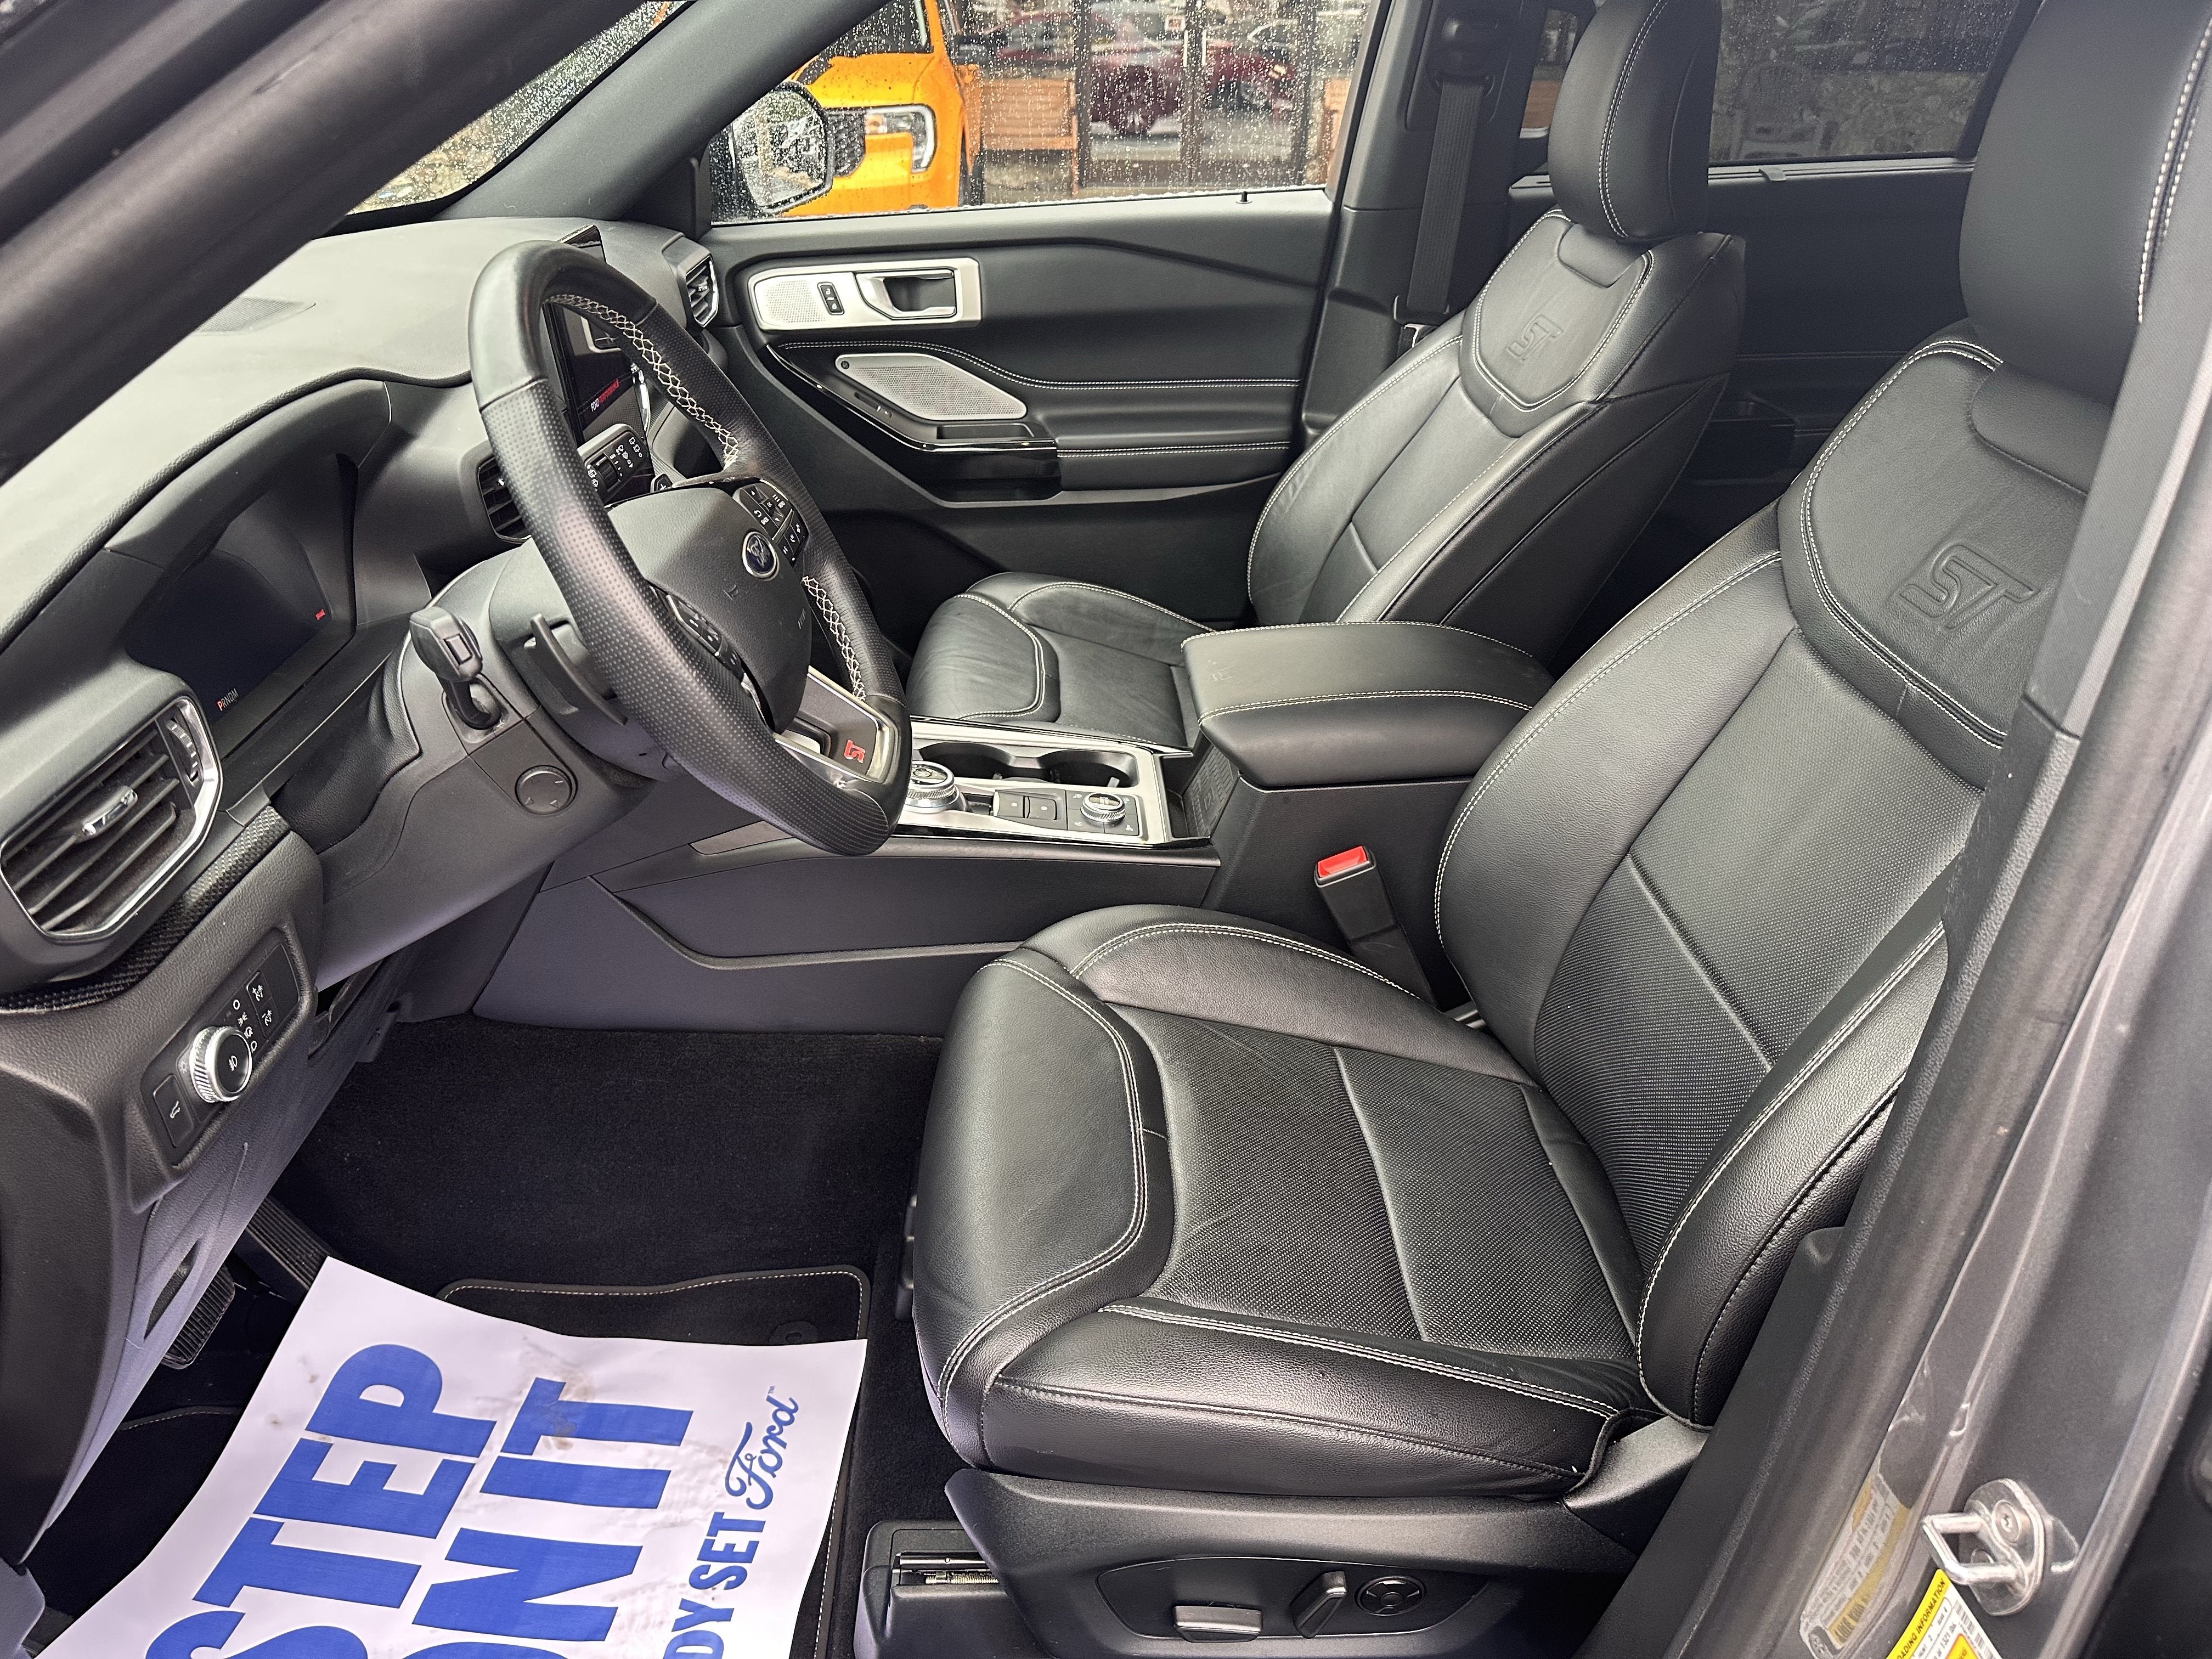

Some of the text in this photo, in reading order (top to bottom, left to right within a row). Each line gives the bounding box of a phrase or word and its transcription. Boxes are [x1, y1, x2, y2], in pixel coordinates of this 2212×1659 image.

[1897, 544, 2040, 630] ST
[843, 740, 866, 764] ST
[480, 1377, 693, 1509] IT
[144, 1344, 497, 1659] STEP
[689, 1511, 766, 1590] SET
[1916, 1579, 1946, 1634] INFORMATION
